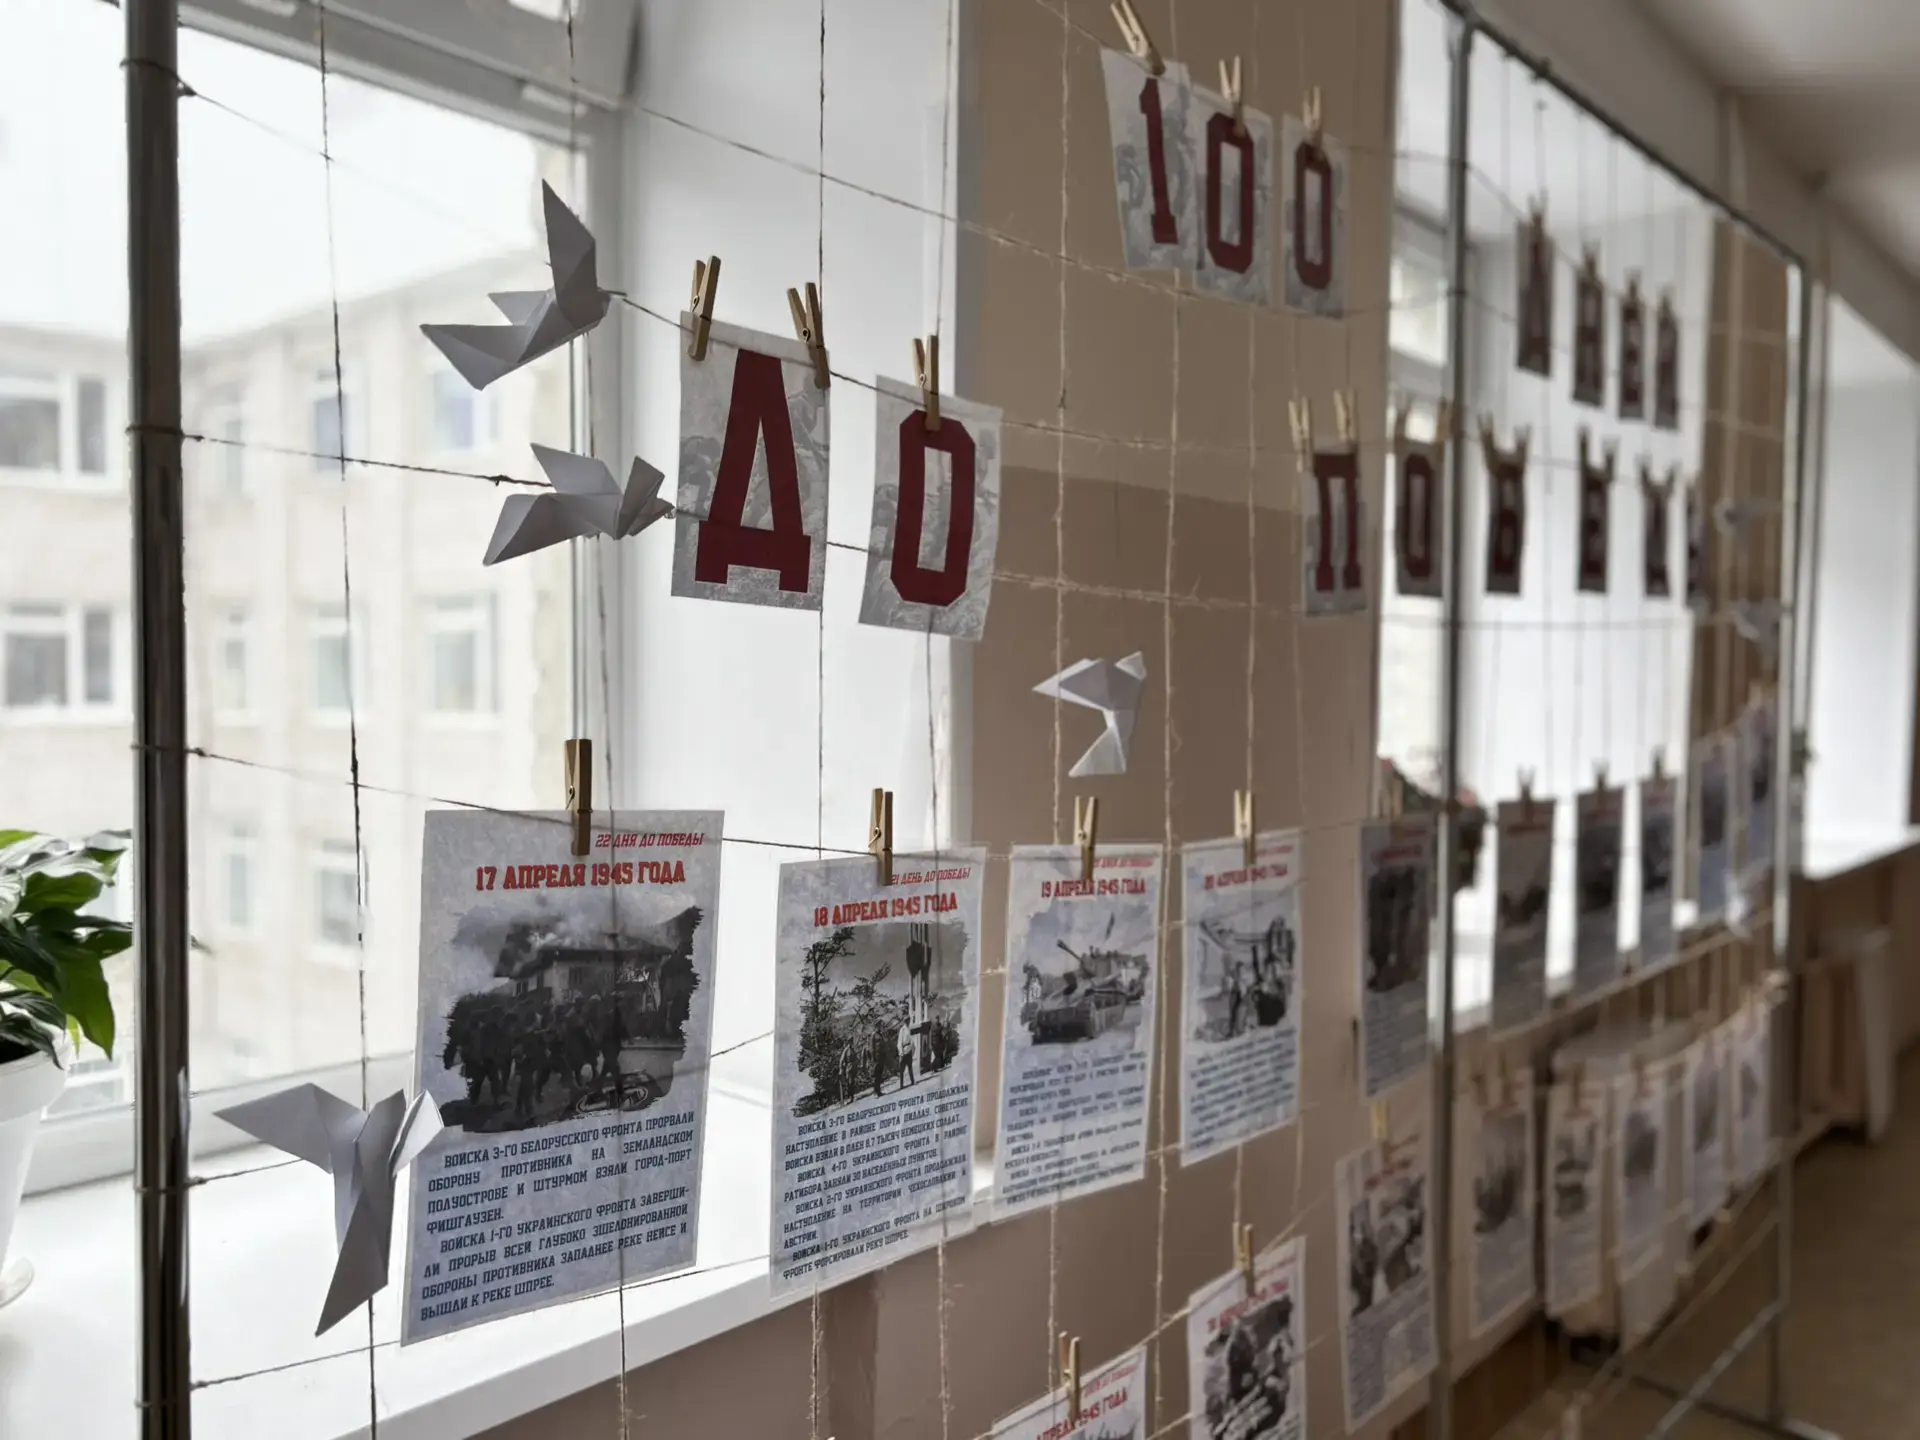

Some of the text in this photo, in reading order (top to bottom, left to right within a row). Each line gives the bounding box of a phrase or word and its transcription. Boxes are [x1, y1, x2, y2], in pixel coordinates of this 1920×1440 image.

[695, 348, 975, 606] ДО
[596, 832, 704, 848] 22 ДНЯ ДО ПОБЕДЫ
[476, 860, 685, 891] 17 АПРЕЛЯ 1945 ГОДА
[901, 872, 923, 885] ДЕНЬ
[924, 871, 936, 882] ДО
[936, 867, 971, 881] ПОБЕДЫ
[814, 892, 958, 927] 18 АПРЕЛЯ 1945 ГОДА
[428, 1130, 692, 1192] ОБОРОНУ ПРОТИВНИКА НА ЗЕМЛАНДСКОМ
[445, 1111, 694, 1168] ВОЙСКА 3-ГО БЕЛОРУССКОГО ФРОНТА ПРОРВАЛИ
[786, 1132, 837, 1154] НАСТУПЛЕНИЕ
[428, 1148, 691, 1213] ПОЛУОСТРОВЕ И ШТУРМОМ ВЗЯЛИ ГОРОД-ПОРТ
[427, 1208, 503, 1234] ФИШГАУЗЕН.
[440, 1186, 688, 1252] ВОЙСКА 1-ГО УКРАИНСКОГО ФРОНТА ЗАВЕРШИ-
[422, 1274, 476, 1298] ОБОРОНЫ
[483, 1256, 554, 1283] ПРОТИВНИКА
[561, 1240, 612, 1263] ЗАПАДНЕЕ
[618, 1233, 642, 1249] РЕКЕ
[680, 1222, 686, 1233] И
[424, 1262, 440, 1277] ЛИ
[449, 1249, 496, 1271] ПРОРЫВ
[504, 1240, 531, 1258] ВСЕЙ
[539, 1228, 585, 1249] ГЛУБОКО
[421, 1275, 554, 1320] ВЫШЛИ К РЕКЕ ШПРЕЕ.
